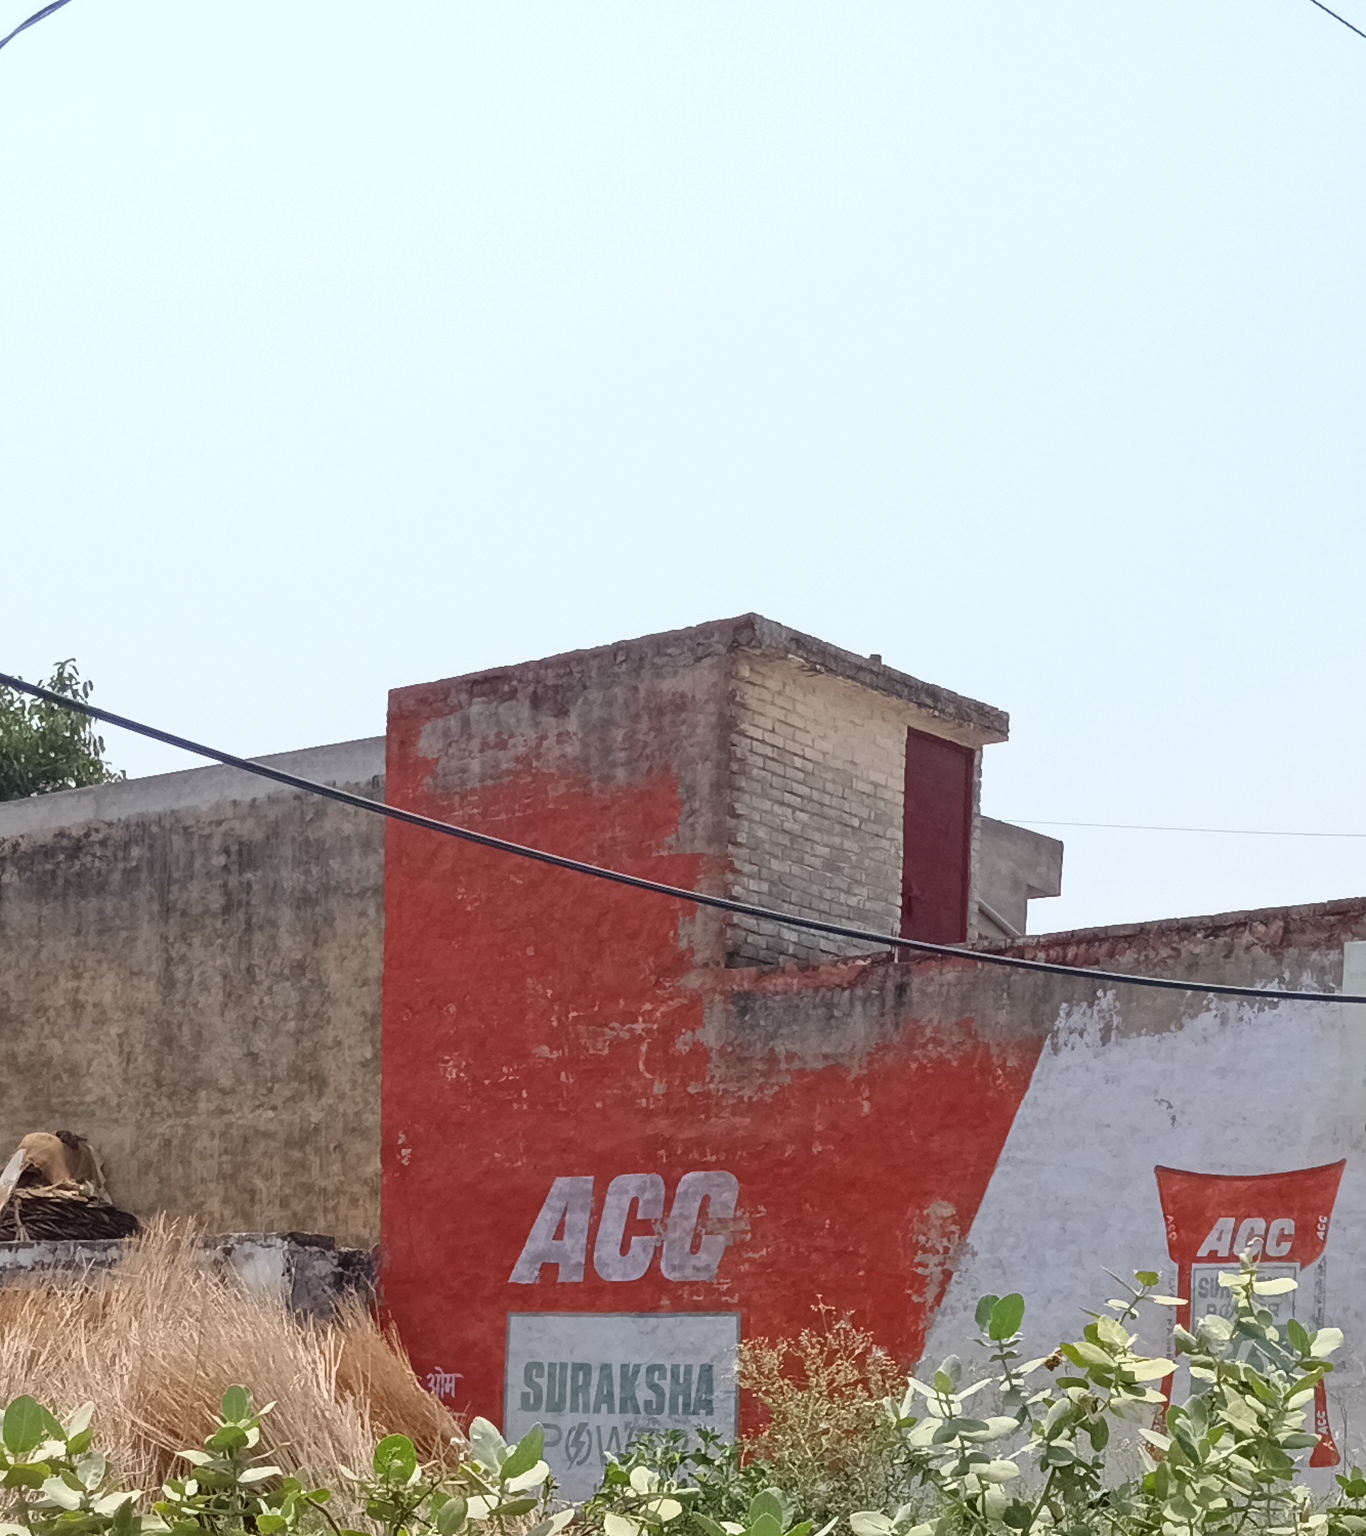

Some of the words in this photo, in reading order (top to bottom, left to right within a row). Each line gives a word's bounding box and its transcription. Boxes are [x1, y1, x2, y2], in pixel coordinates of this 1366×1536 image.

[508, 1170, 740, 1284] ACC
[1196, 1217, 1296, 1258] ACC
[1316, 1215, 1328, 1241] ACC
[520, 1361, 715, 1416] SURAKSHA
[1317, 1410, 1329, 1436] ACC
